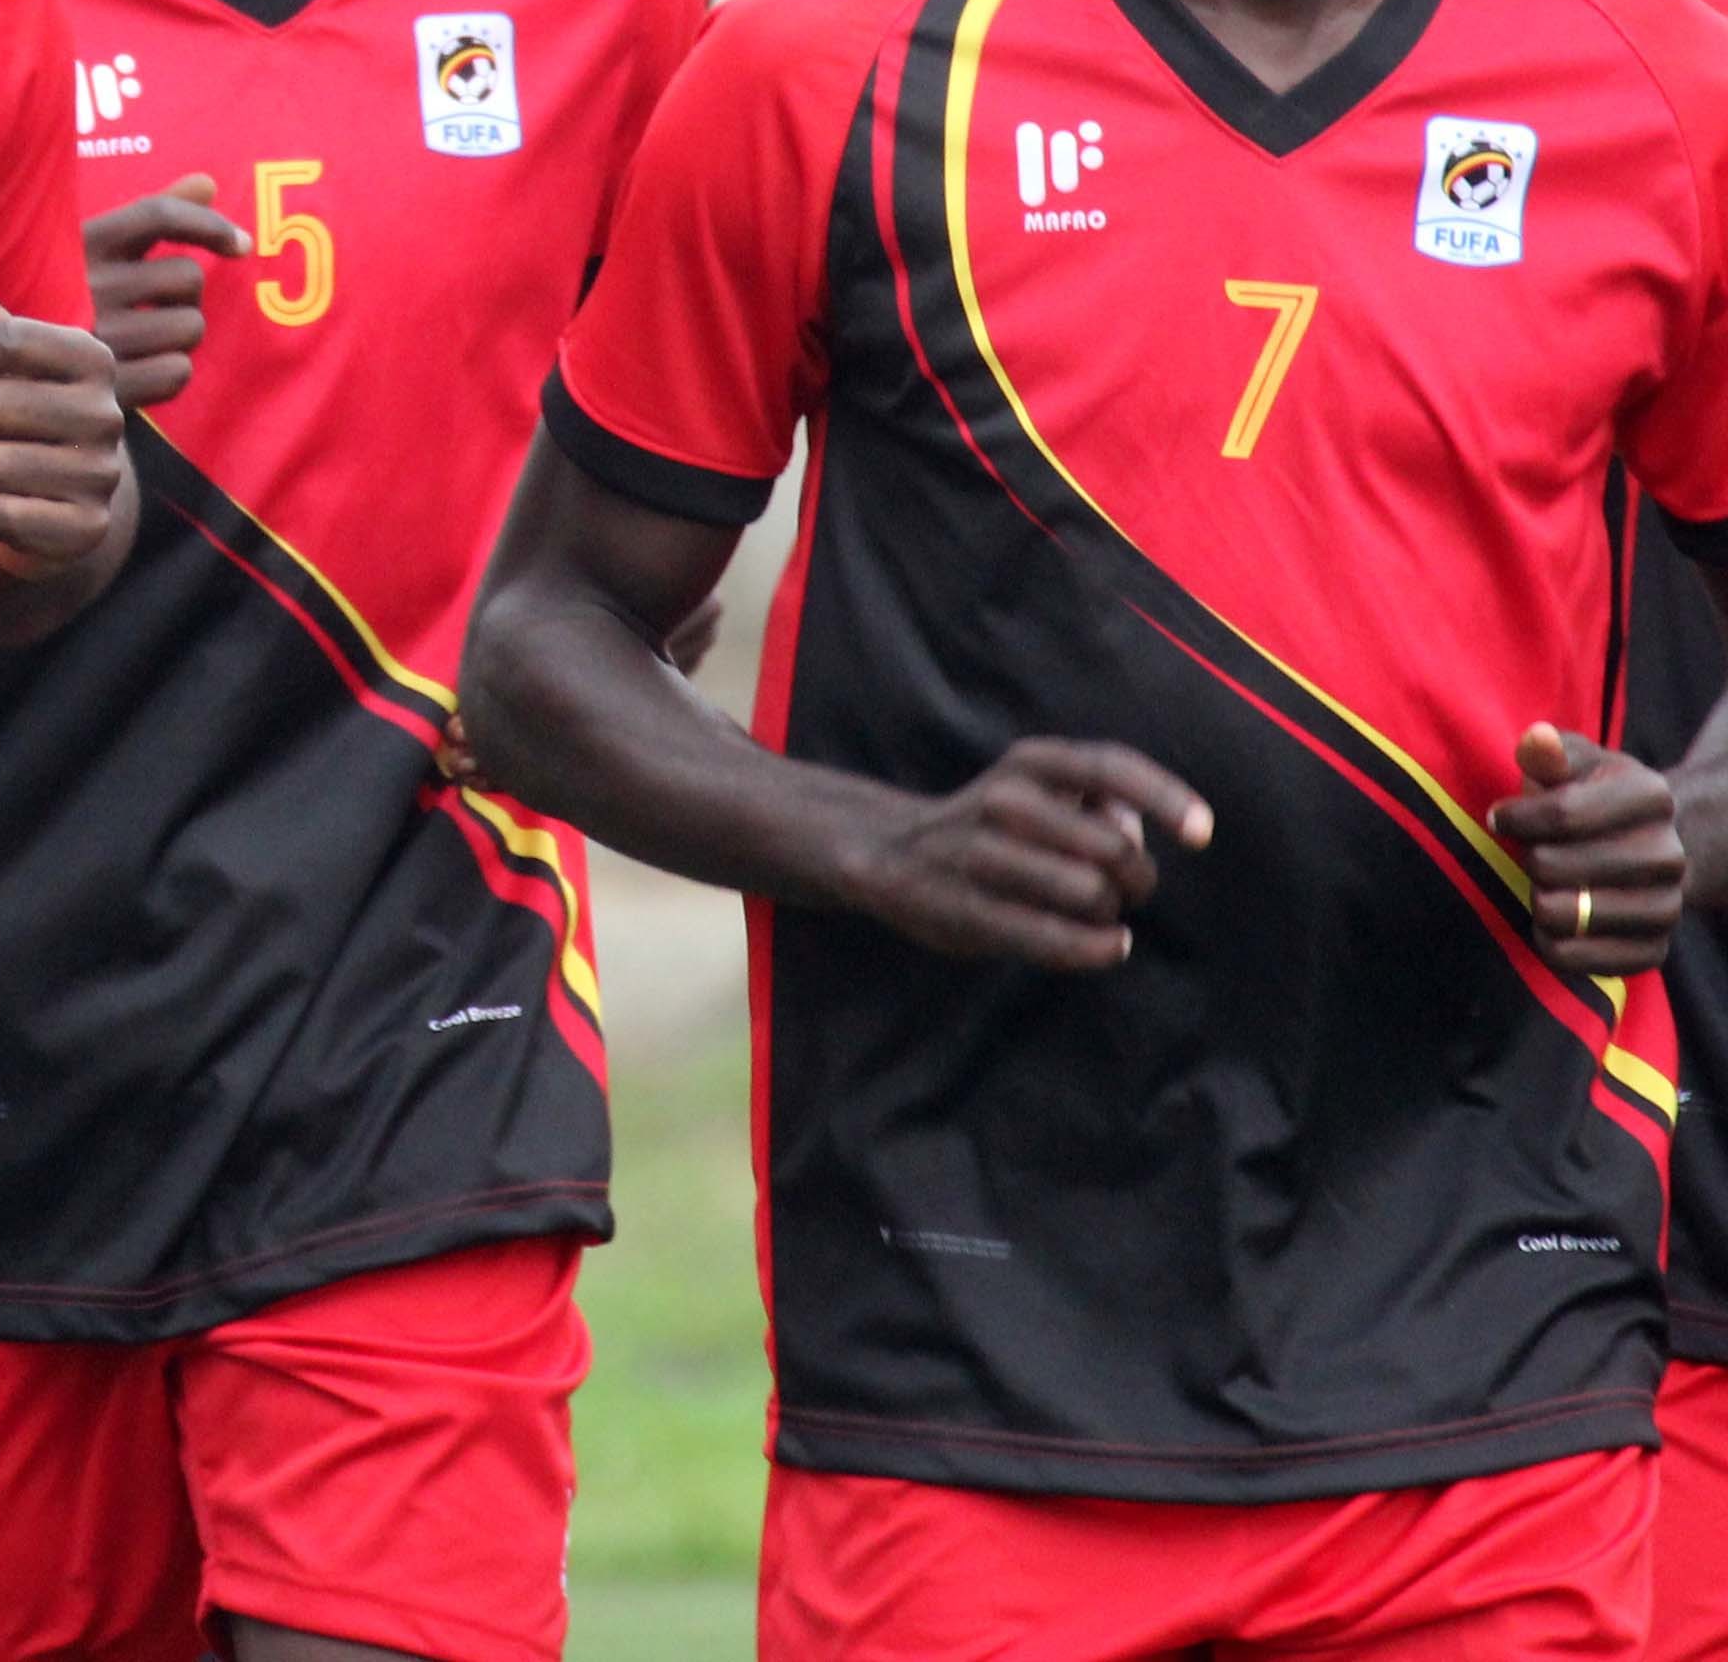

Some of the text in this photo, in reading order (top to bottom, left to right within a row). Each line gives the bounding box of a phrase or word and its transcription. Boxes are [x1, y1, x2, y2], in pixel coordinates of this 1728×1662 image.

[443, 123, 504, 144] FUFA
[253, 159, 335, 327] 5
[1434, 227, 1501, 253] FUFA
[1220, 278, 1320, 460] 7
[427, 1005, 522, 1031] Cool Breeze
[1518, 1233, 1620, 1252] Cool Breeze
